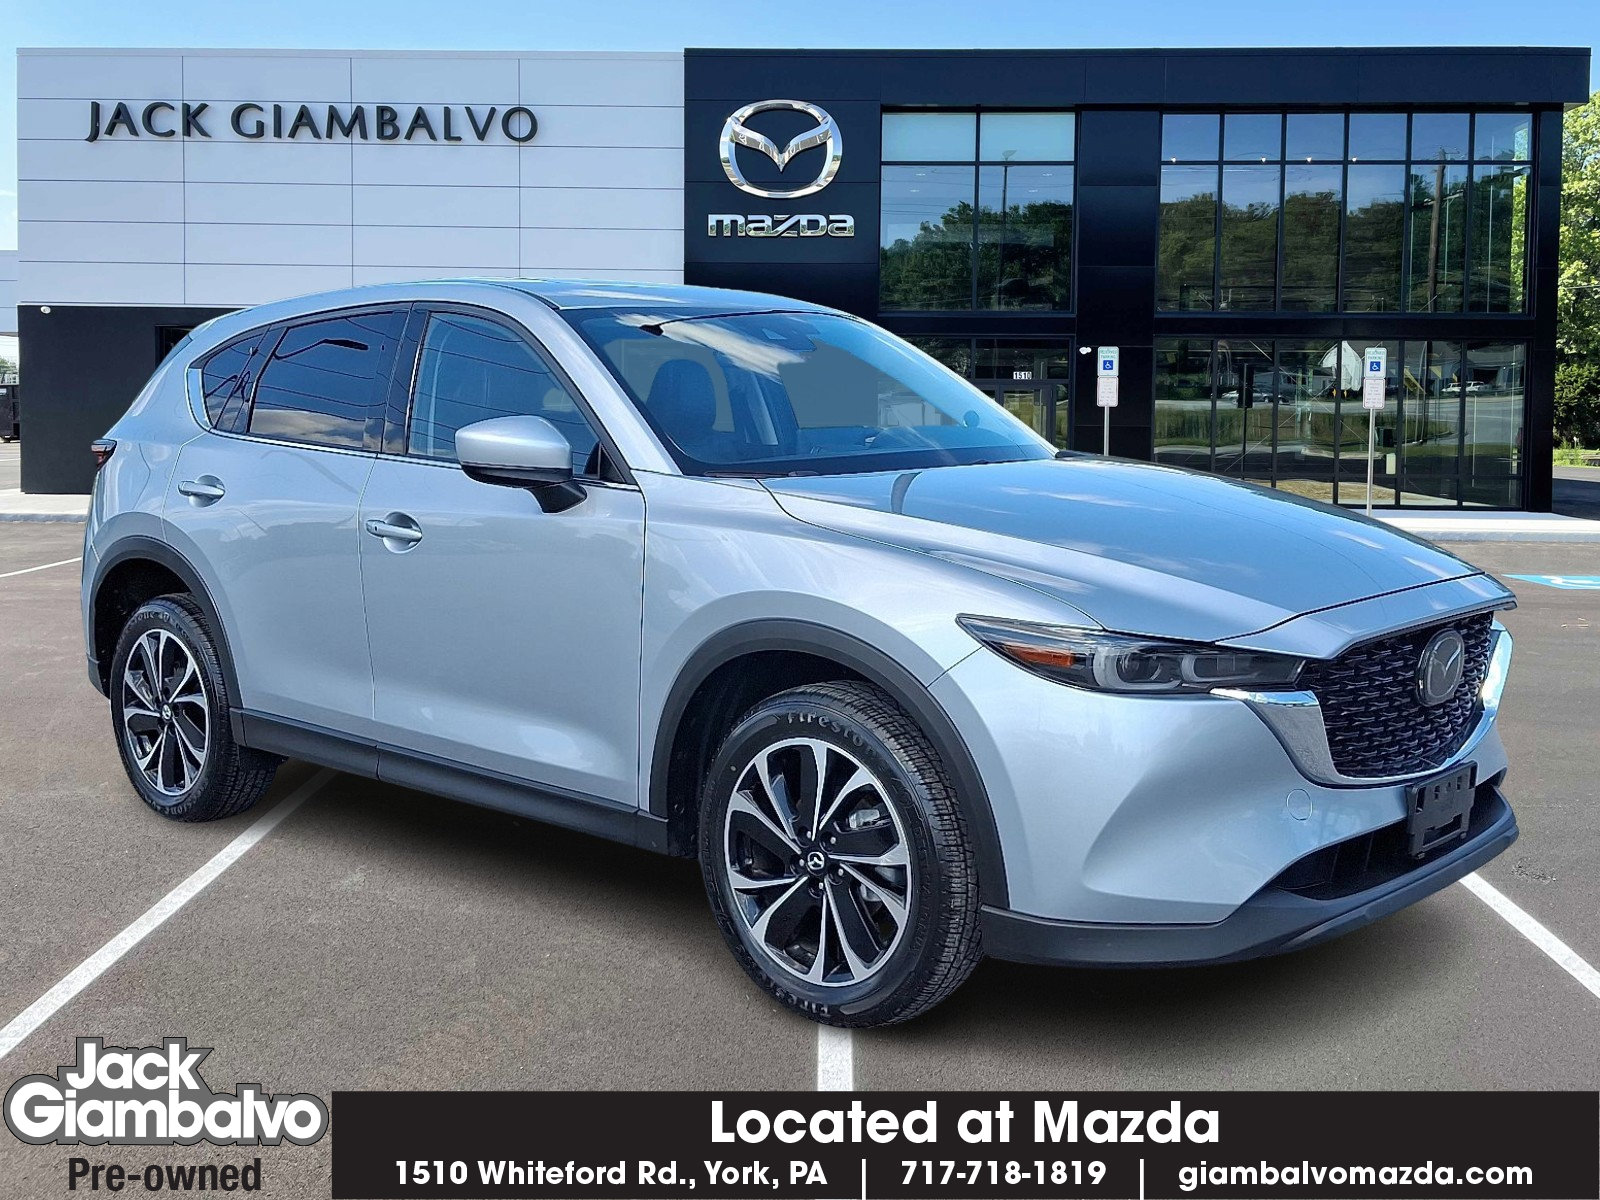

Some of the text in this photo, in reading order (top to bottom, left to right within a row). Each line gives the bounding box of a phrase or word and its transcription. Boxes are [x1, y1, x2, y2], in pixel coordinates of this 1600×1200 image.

[85, 101, 538, 143] JACK GIAMBALVO
[707, 213, 855, 238] mazda
[1014, 372, 1032, 380] 1510
